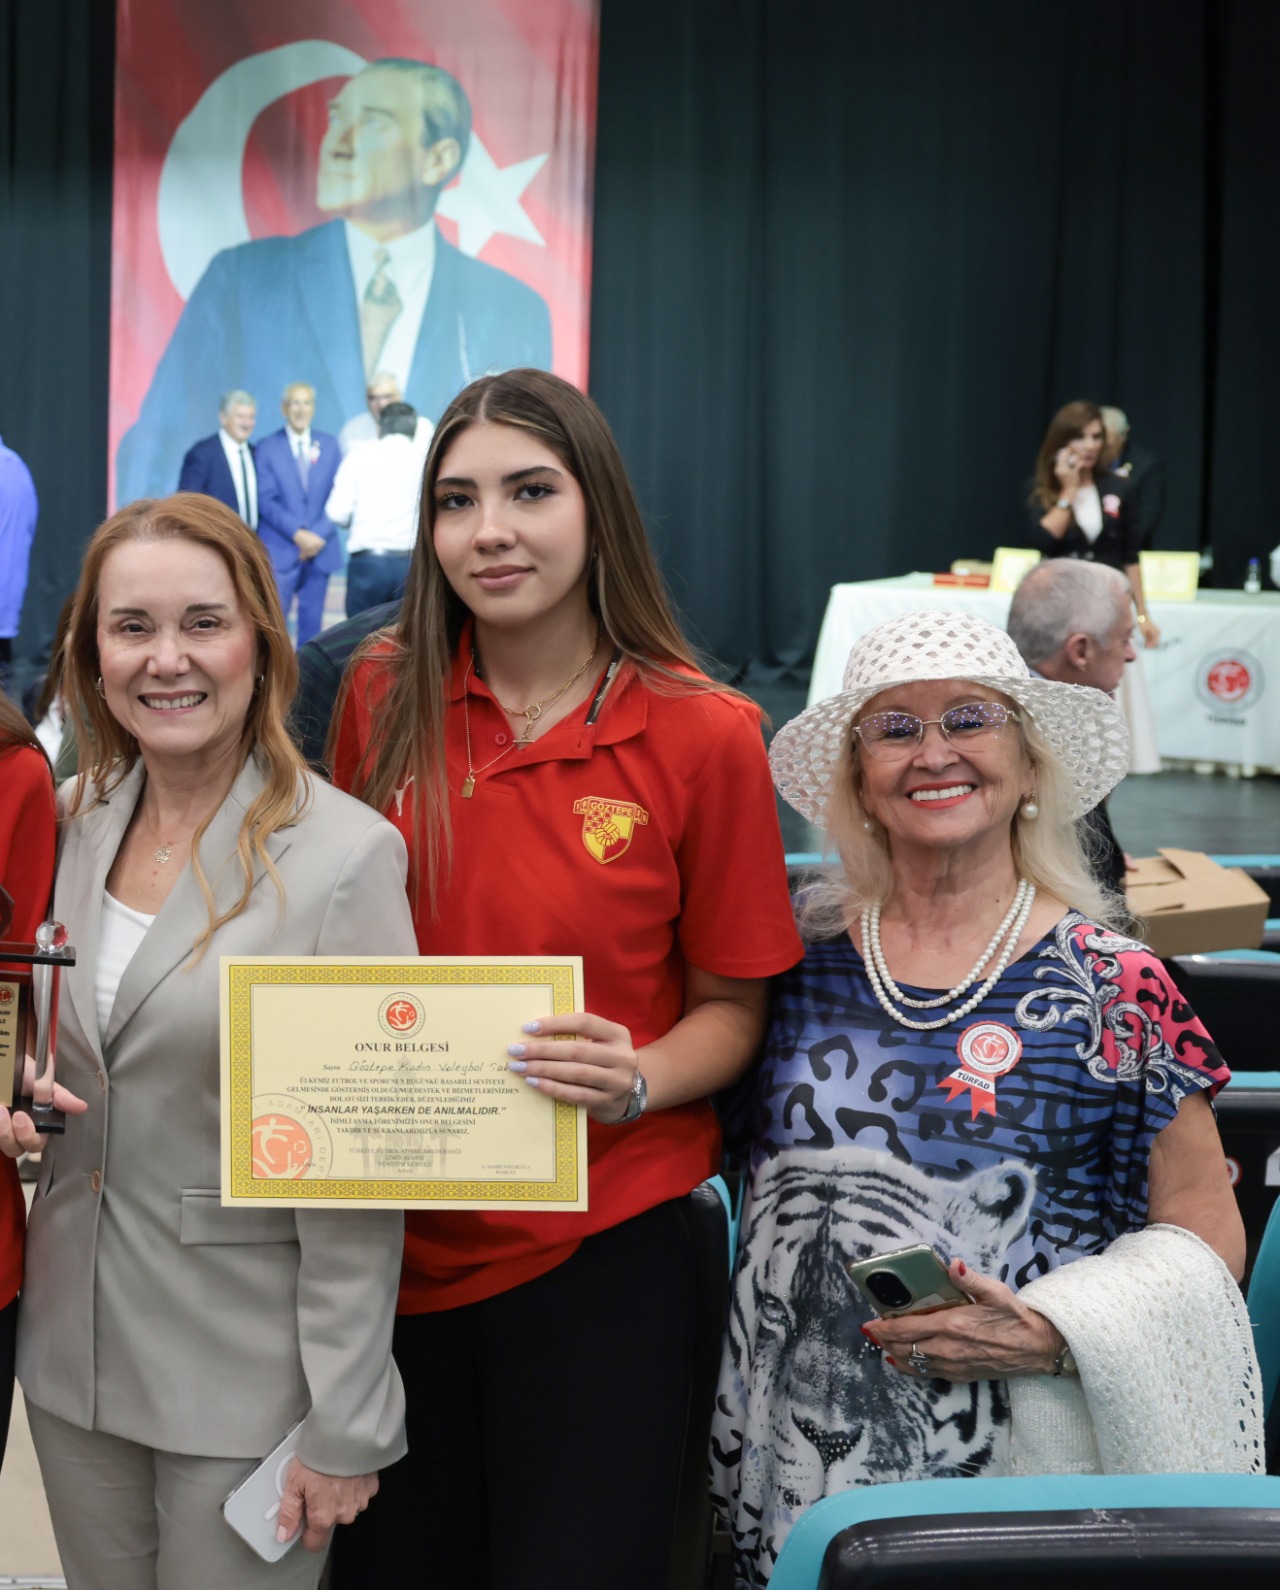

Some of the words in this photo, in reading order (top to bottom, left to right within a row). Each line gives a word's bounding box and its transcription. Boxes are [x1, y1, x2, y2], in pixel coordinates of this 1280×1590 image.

[355, 1043, 391, 1052] ONUR
[395, 1042, 449, 1052] BELGESİ
[958, 1072, 990, 1090] TÜRFAD
[287, 1086, 330, 1094] GELMESİNDE
[331, 1086, 370, 1094] GÖSTERMİŞ
[414, 1086, 440, 1094] DESTEK
[441, 1086, 450, 1094] VE
[452, 1086, 519, 1094] HİZMETLERİNİZDEN
[361, 1106, 415, 1115] YAŞARKEN
[418, 1106, 431, 1115] DE
